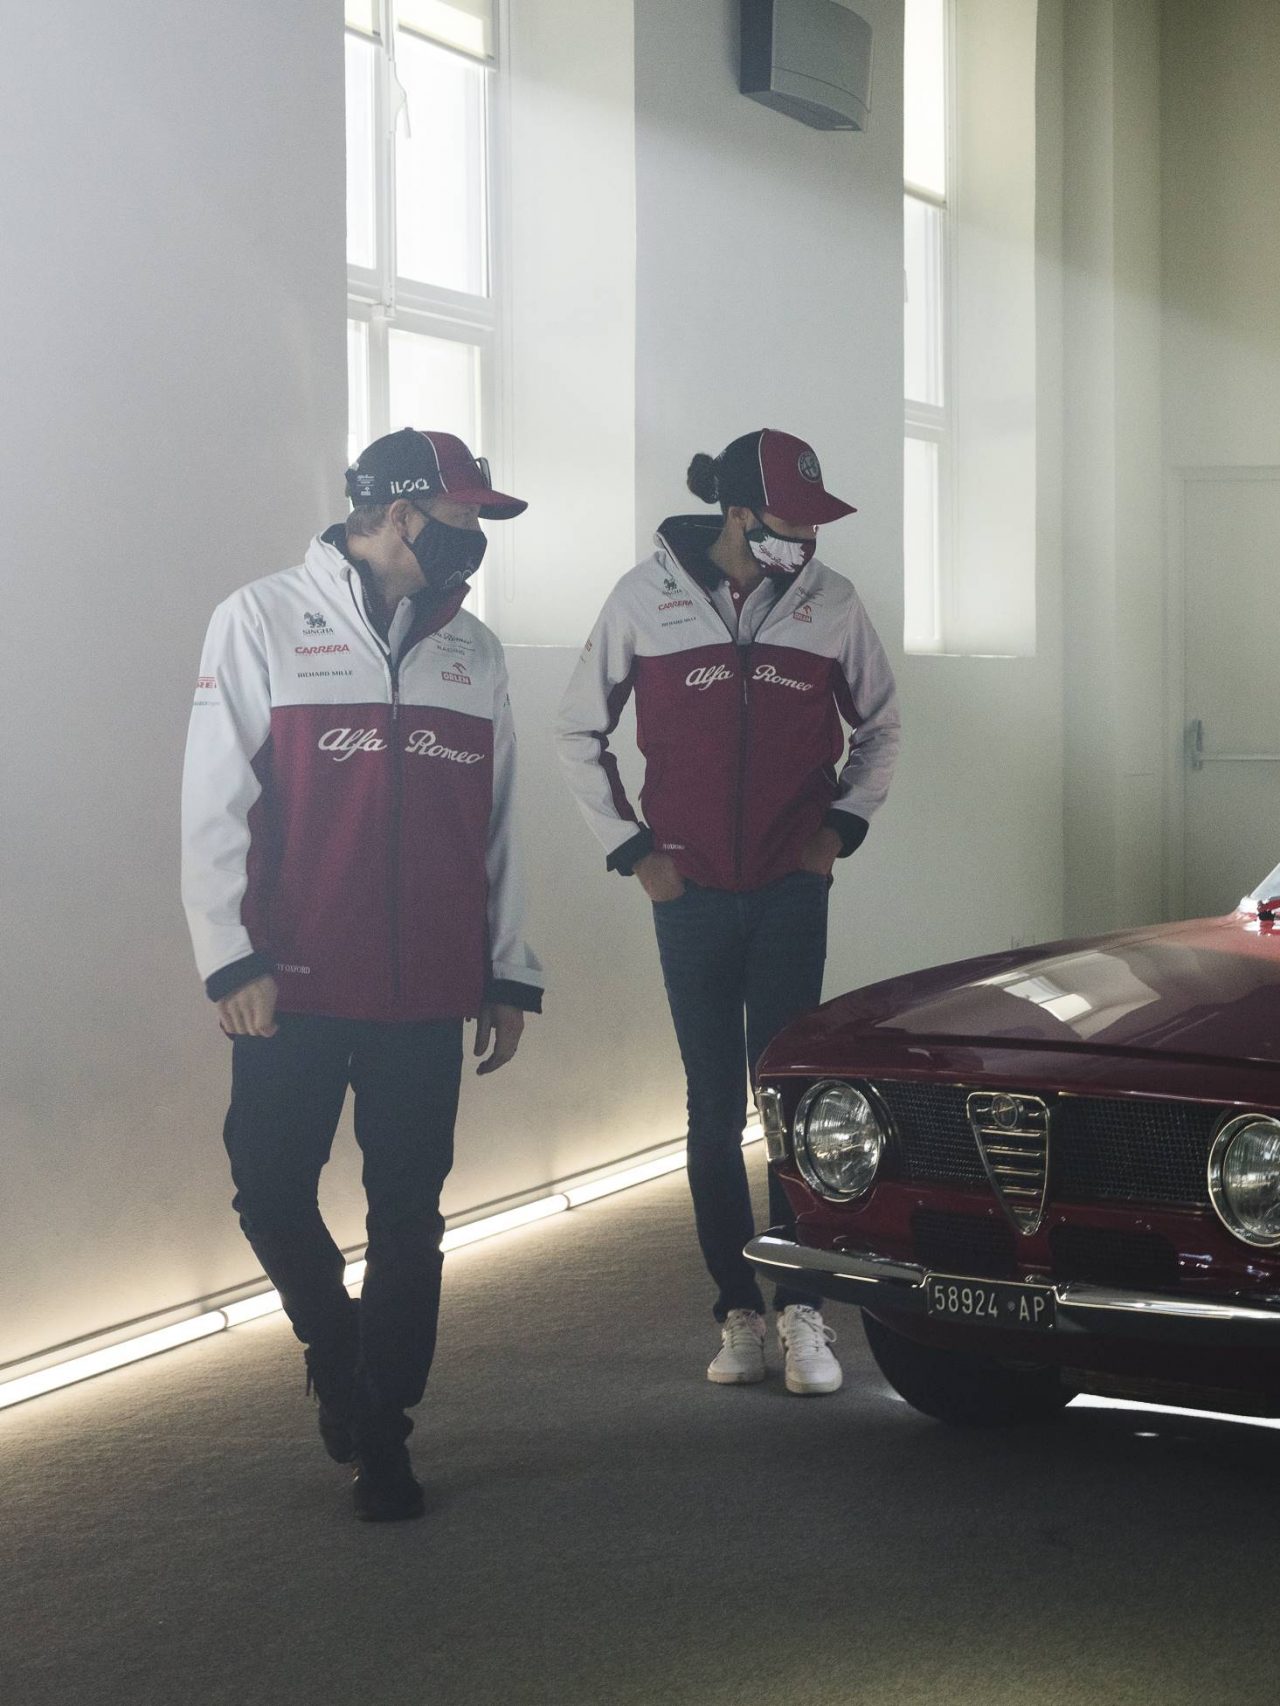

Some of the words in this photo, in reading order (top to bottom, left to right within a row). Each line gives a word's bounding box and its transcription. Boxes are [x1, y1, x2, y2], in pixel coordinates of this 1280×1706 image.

[658, 599, 693, 611] CARRERA
[295, 643, 351, 654] CARRERA
[685, 664, 734, 691] Alfa
[752, 664, 814, 692] Romeo
[317, 727, 388, 762] Alfa
[404, 729, 485, 765] Romeo
[934, 1285, 999, 1318] 58924
[1019, 1295, 1045, 1322] AP
